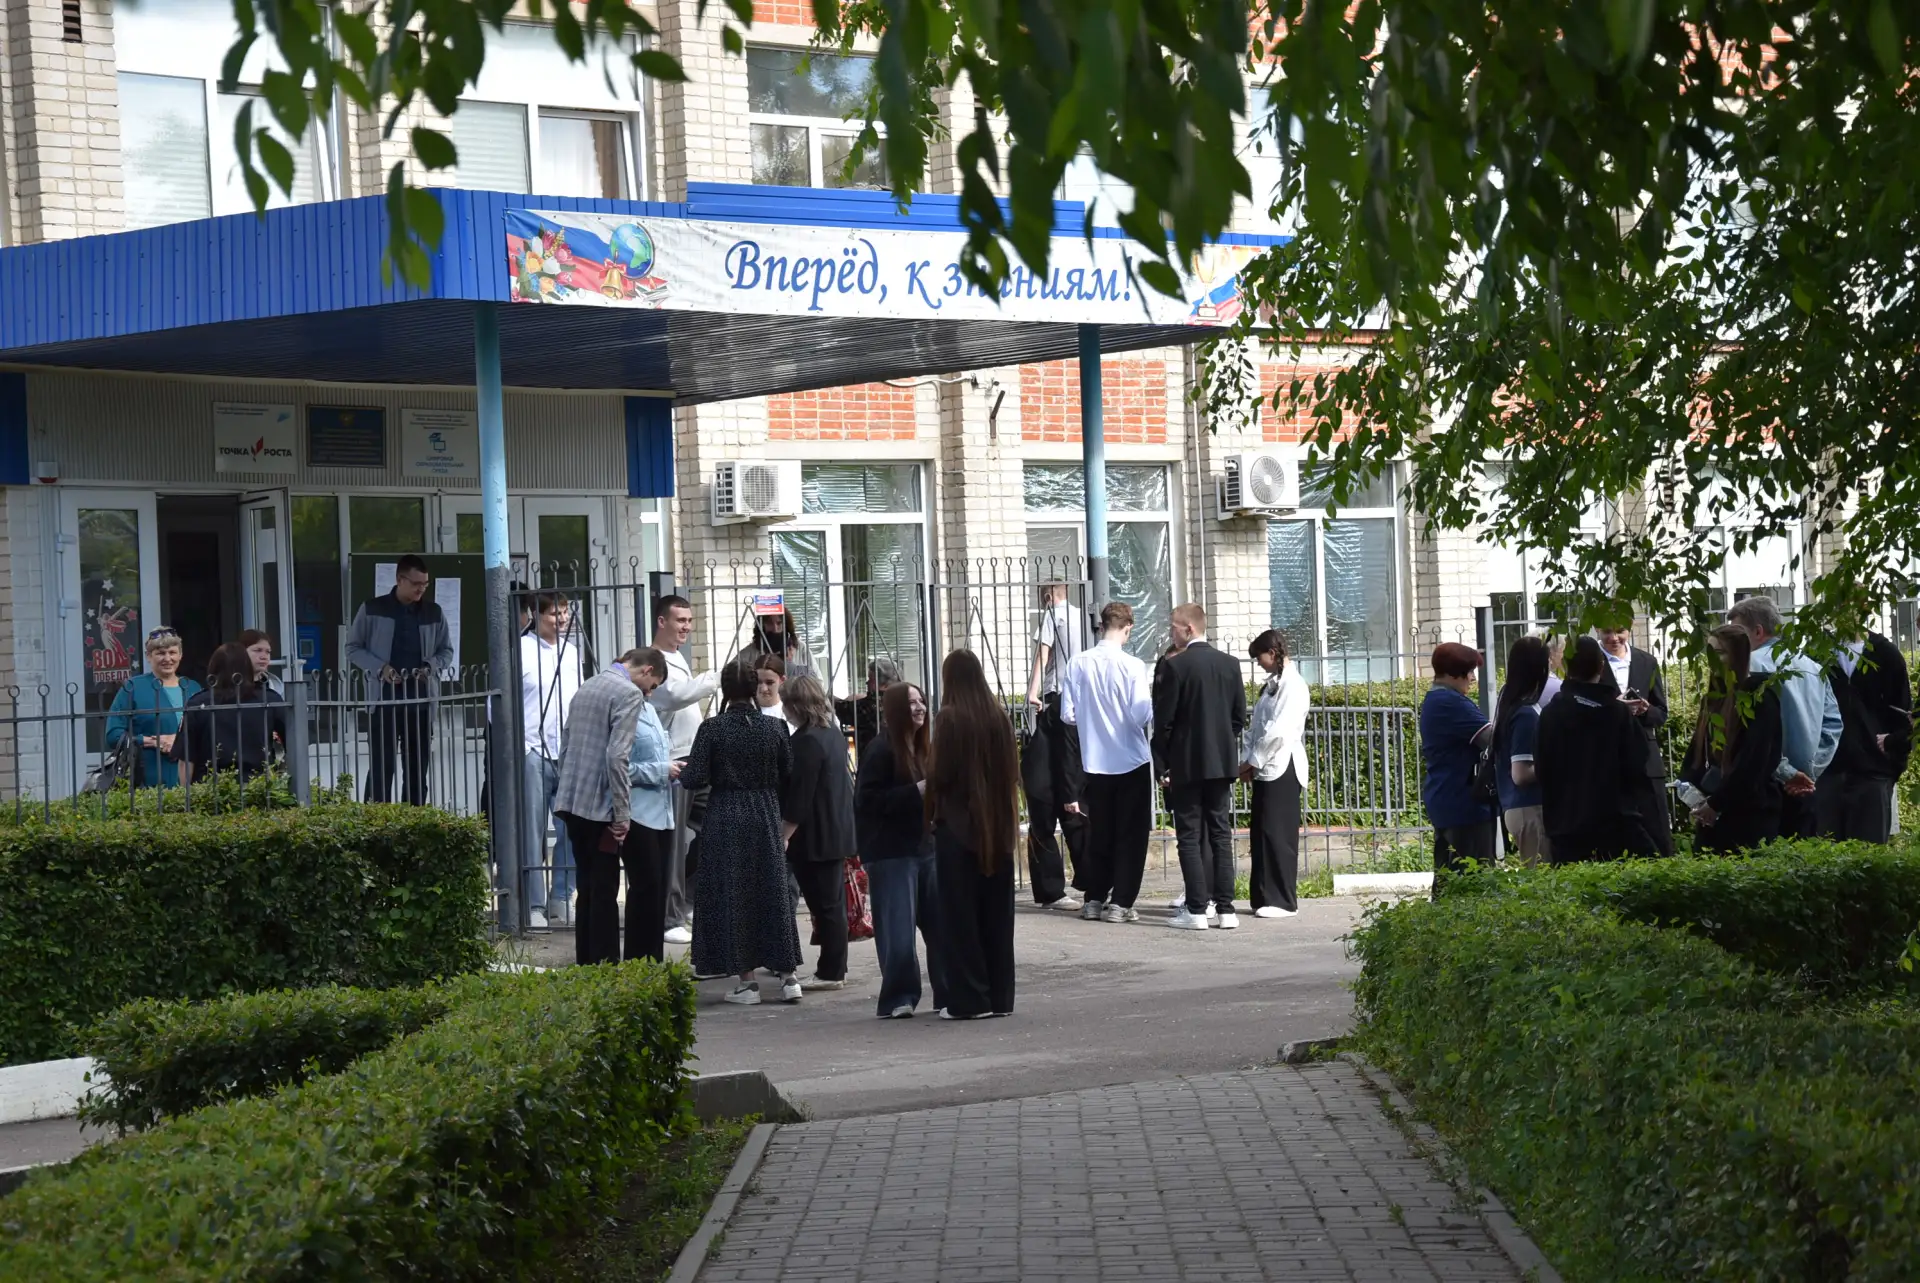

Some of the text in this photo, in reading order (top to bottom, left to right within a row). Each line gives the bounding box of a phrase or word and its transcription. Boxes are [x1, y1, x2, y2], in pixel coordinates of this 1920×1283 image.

[725, 238, 888, 311] Вперёд,
[219, 447, 293, 457] ТОЧКА РОСТА
